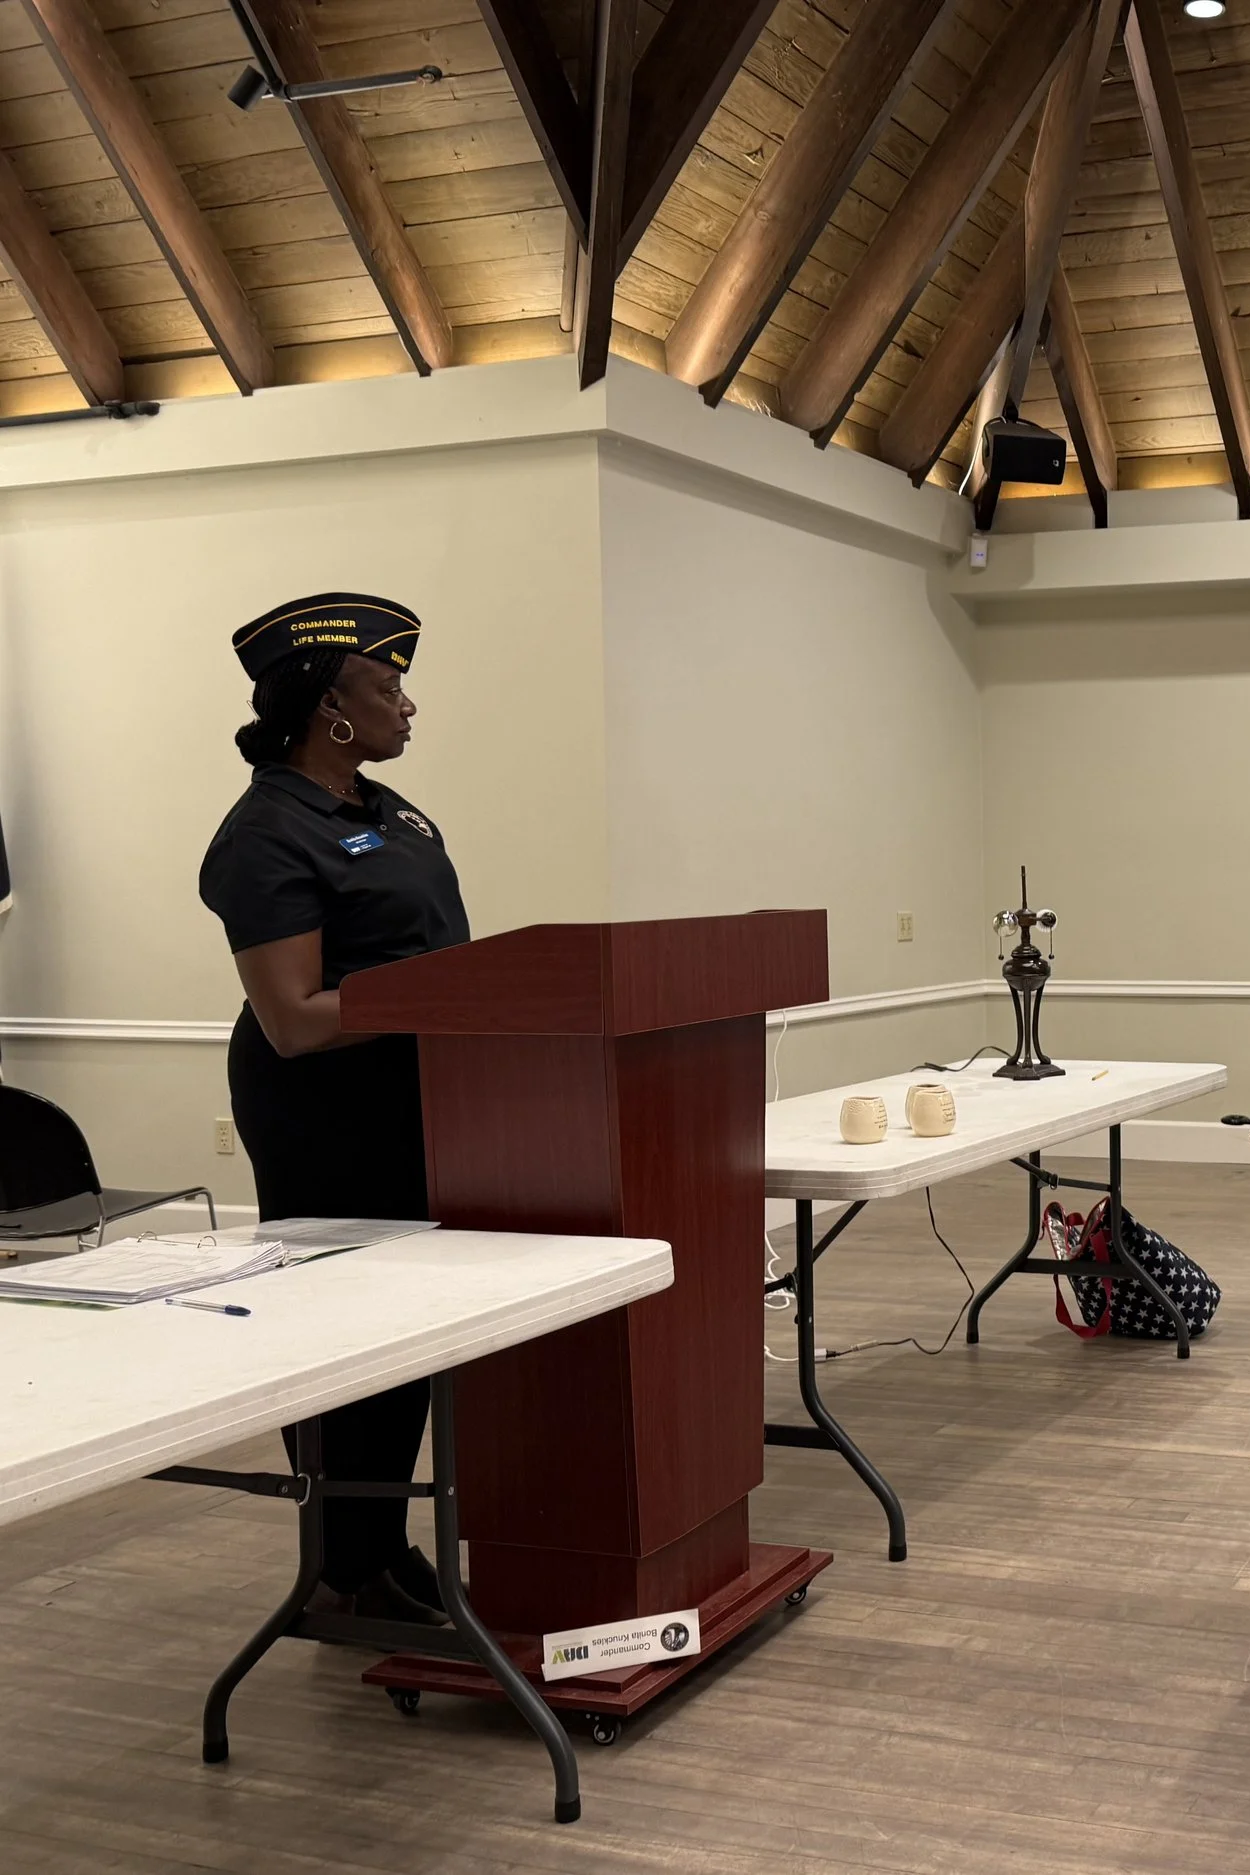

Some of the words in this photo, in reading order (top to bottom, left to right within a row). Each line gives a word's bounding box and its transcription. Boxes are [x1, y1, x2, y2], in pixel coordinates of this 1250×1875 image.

[290, 619, 357, 632] COMMANDER
[292, 635, 314, 646] LIFE
[316, 634, 359, 645] MEMBER
[592, 1633, 630, 1647] Knuckles
[631, 1628, 658, 1639] Bonita
[553, 1646, 588, 1664] DAV
[600, 1642, 651, 1657] Commander
